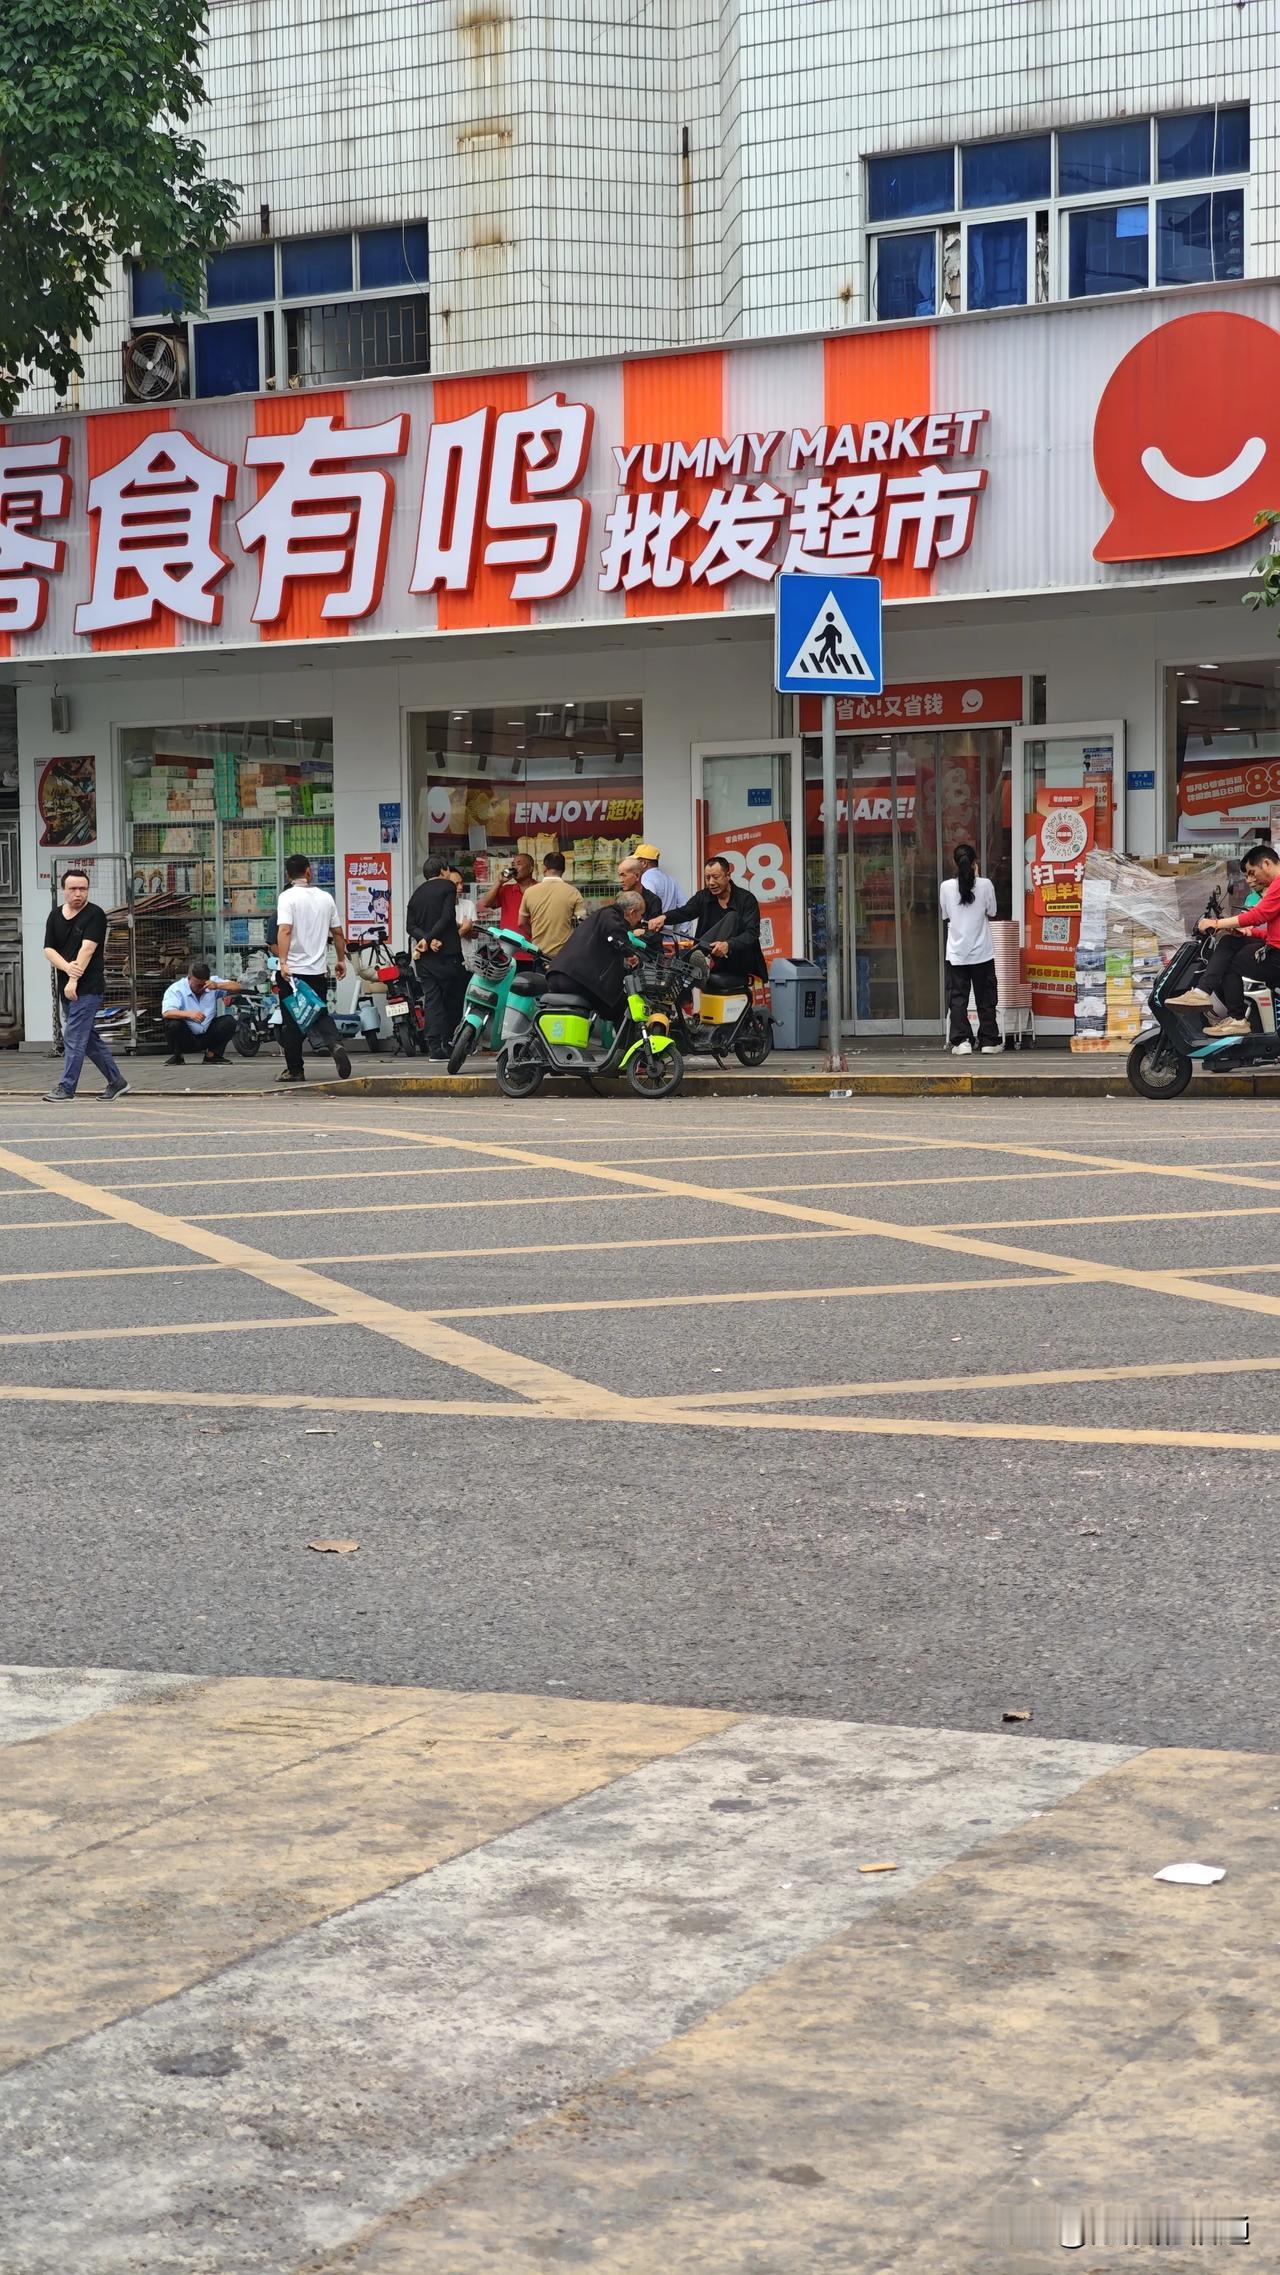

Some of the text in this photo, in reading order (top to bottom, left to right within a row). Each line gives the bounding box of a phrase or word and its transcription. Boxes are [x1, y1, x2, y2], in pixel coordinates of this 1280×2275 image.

[611, 409, 990, 486] YUMMY MARKET
[598, 464, 988, 592] 批发超市
[836, 693, 944, 721] 省心!又省钱
[514, 799, 608, 824] ENJOY!
